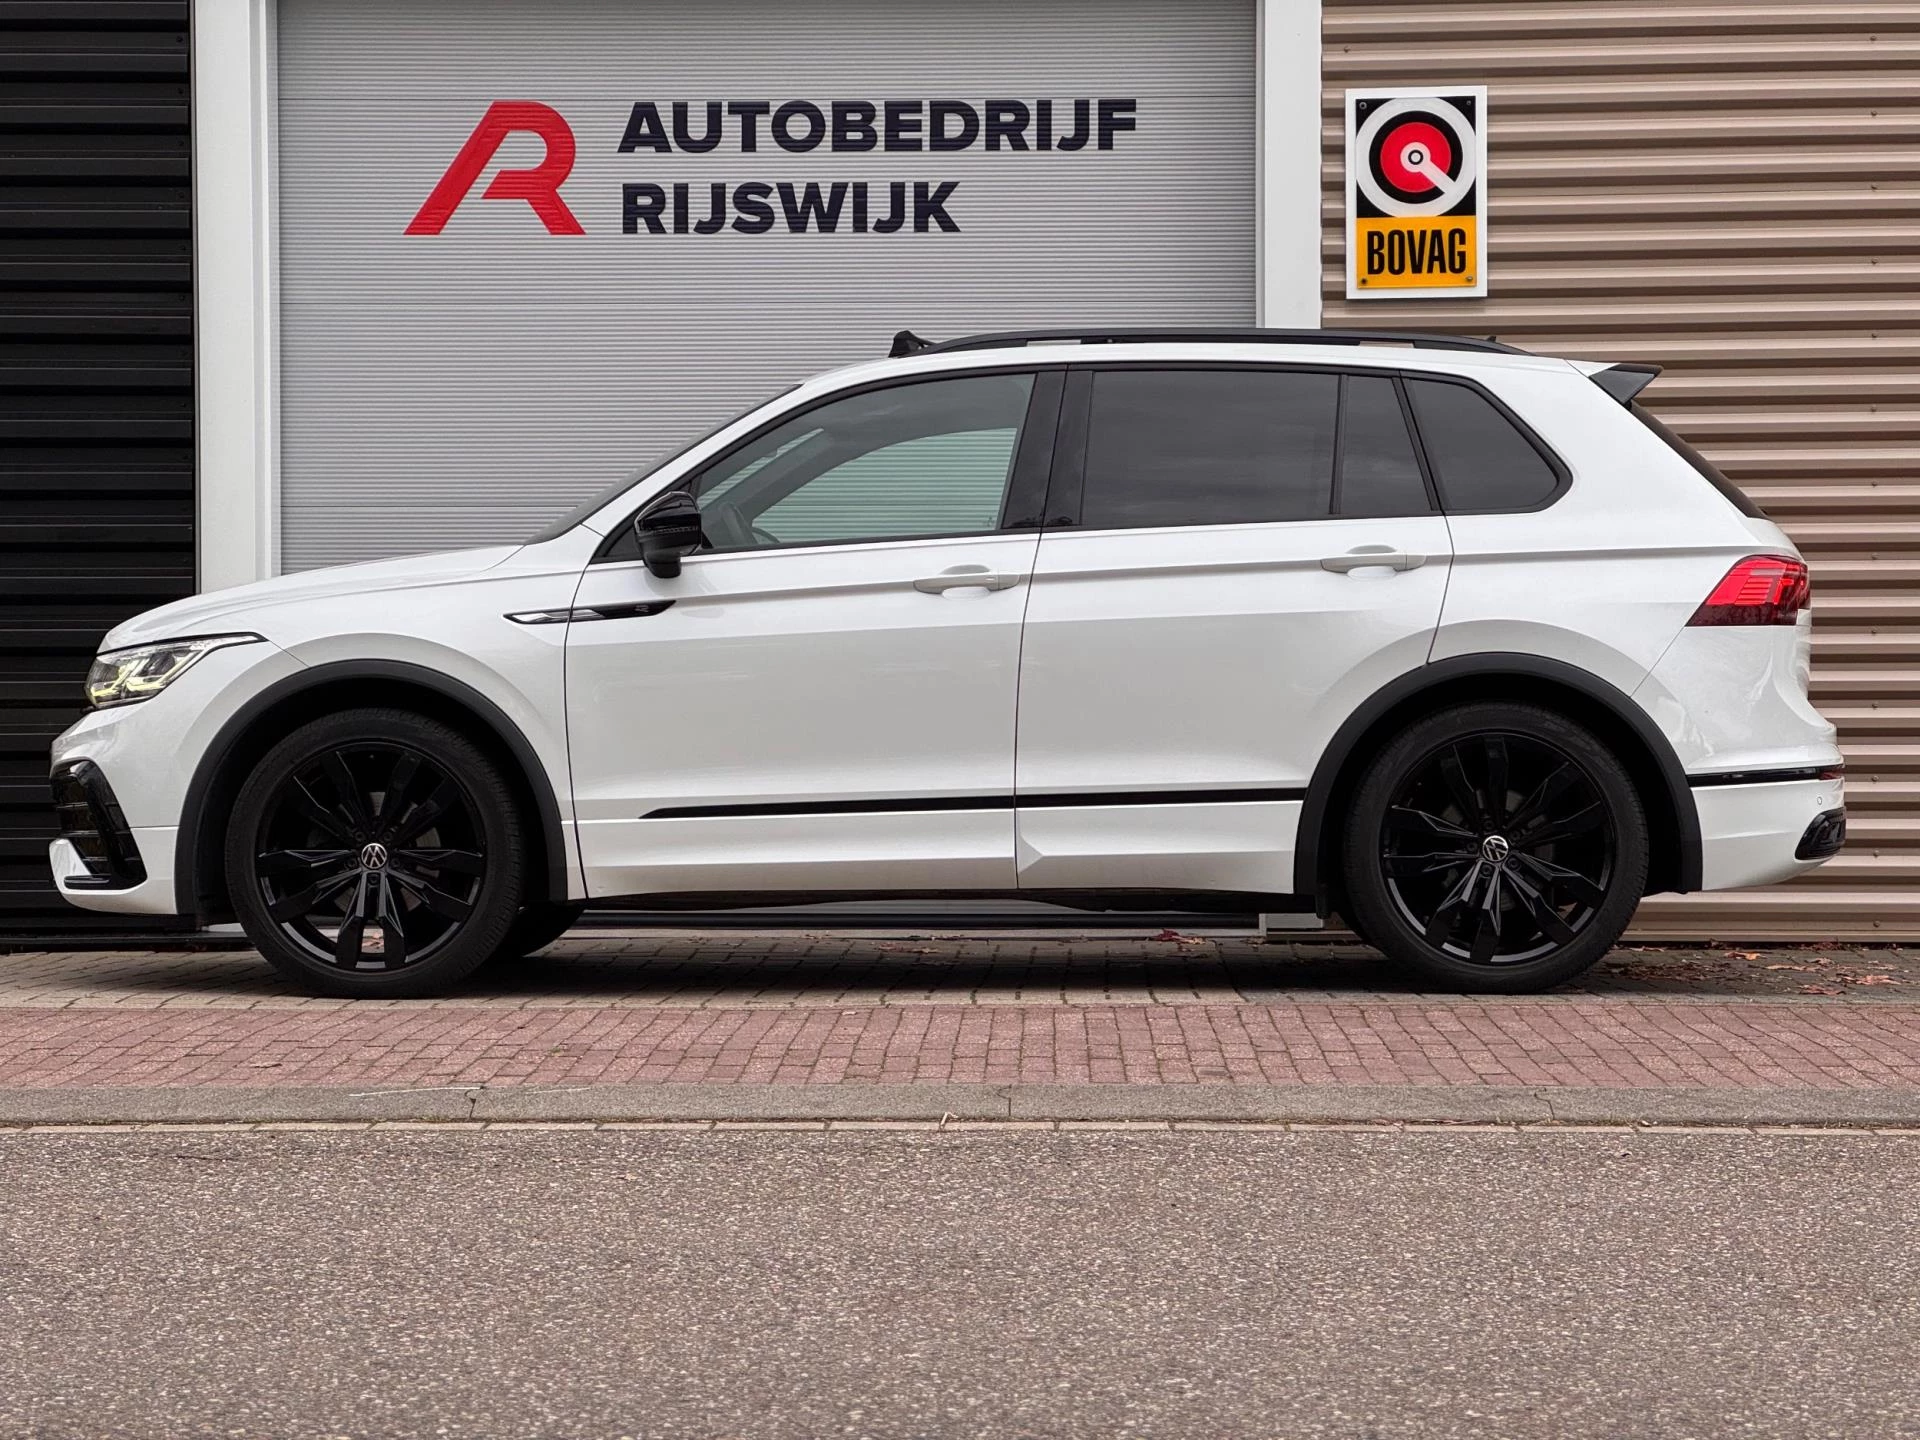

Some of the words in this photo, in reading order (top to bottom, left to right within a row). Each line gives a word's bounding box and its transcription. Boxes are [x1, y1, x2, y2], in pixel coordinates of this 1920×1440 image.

[617, 98, 1137, 154] AUTOBEDRIJF
[622, 181, 962, 235] RIJSWIJK
[1366, 228, 1467, 276] BOVAG
